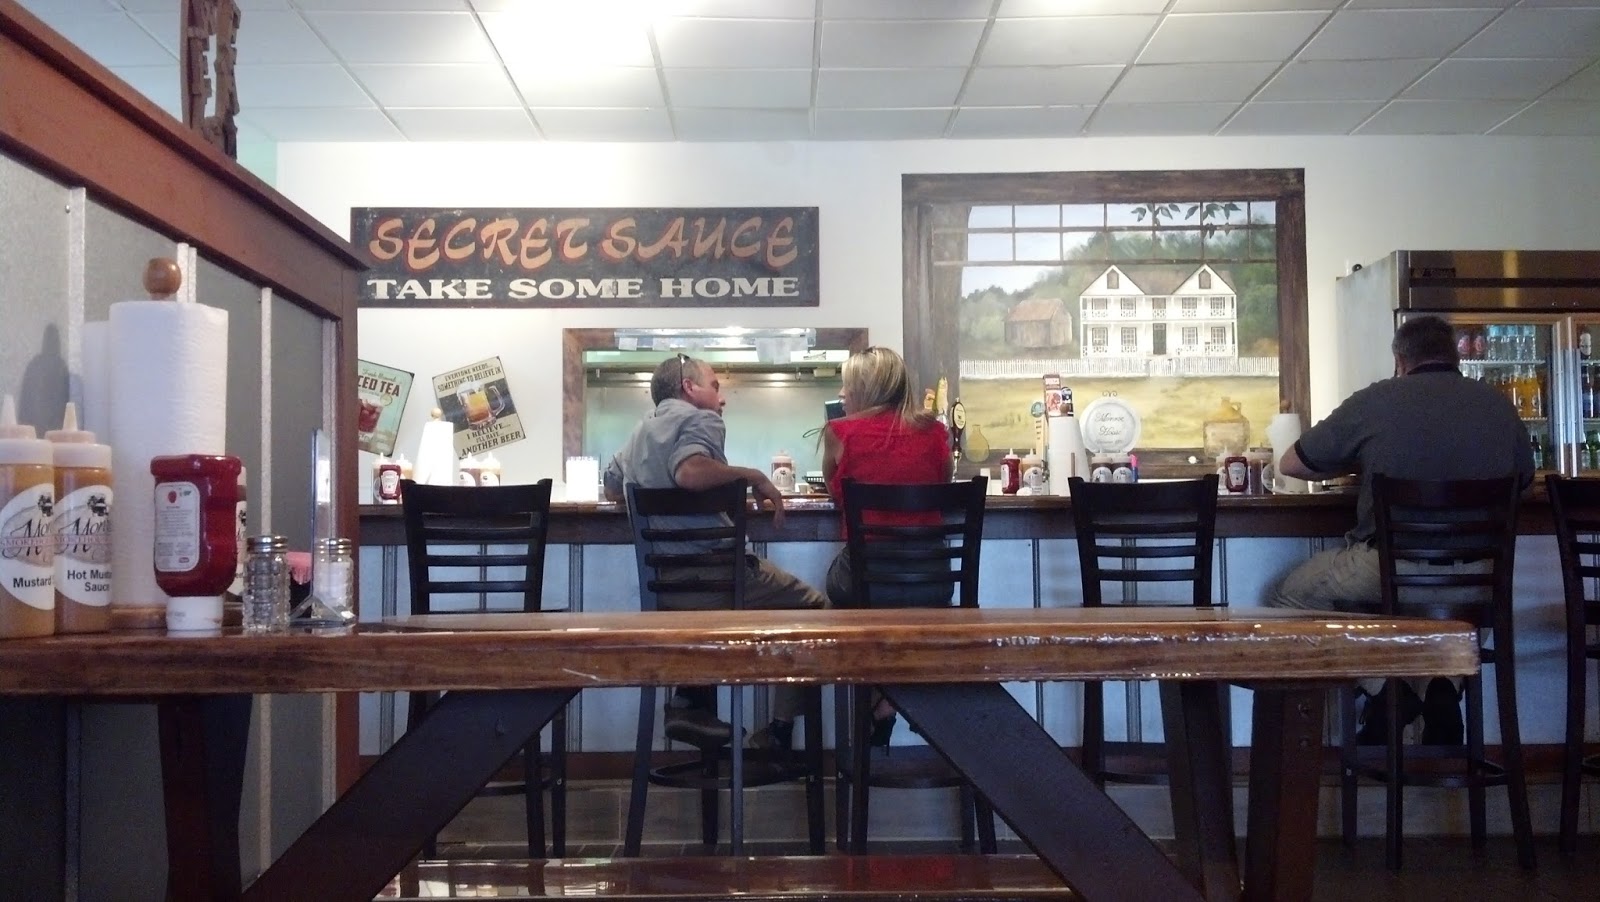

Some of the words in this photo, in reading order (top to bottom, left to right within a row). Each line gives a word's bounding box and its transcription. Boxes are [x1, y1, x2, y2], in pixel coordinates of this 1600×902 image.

[369, 216, 591, 270] SECRET
[601, 216, 799, 269] SAUCE
[366, 277, 493, 300] TAKE
[508, 277, 645, 300] SOME
[659, 276, 800, 299] HOME
[358, 375, 379, 391] CED
[379, 380, 400, 397] TEA
[437, 376, 467, 392] SOMETHING
[467, 374, 475, 382] TO
[474, 368, 496, 381] BELIEVE
[444, 369, 471, 381] EVERYONE
[461, 437, 499, 457] ANOTHER
[500, 430, 522, 444] BEER
[13, 577, 52, 588] Mustard
[67, 569, 87, 580] Hot
